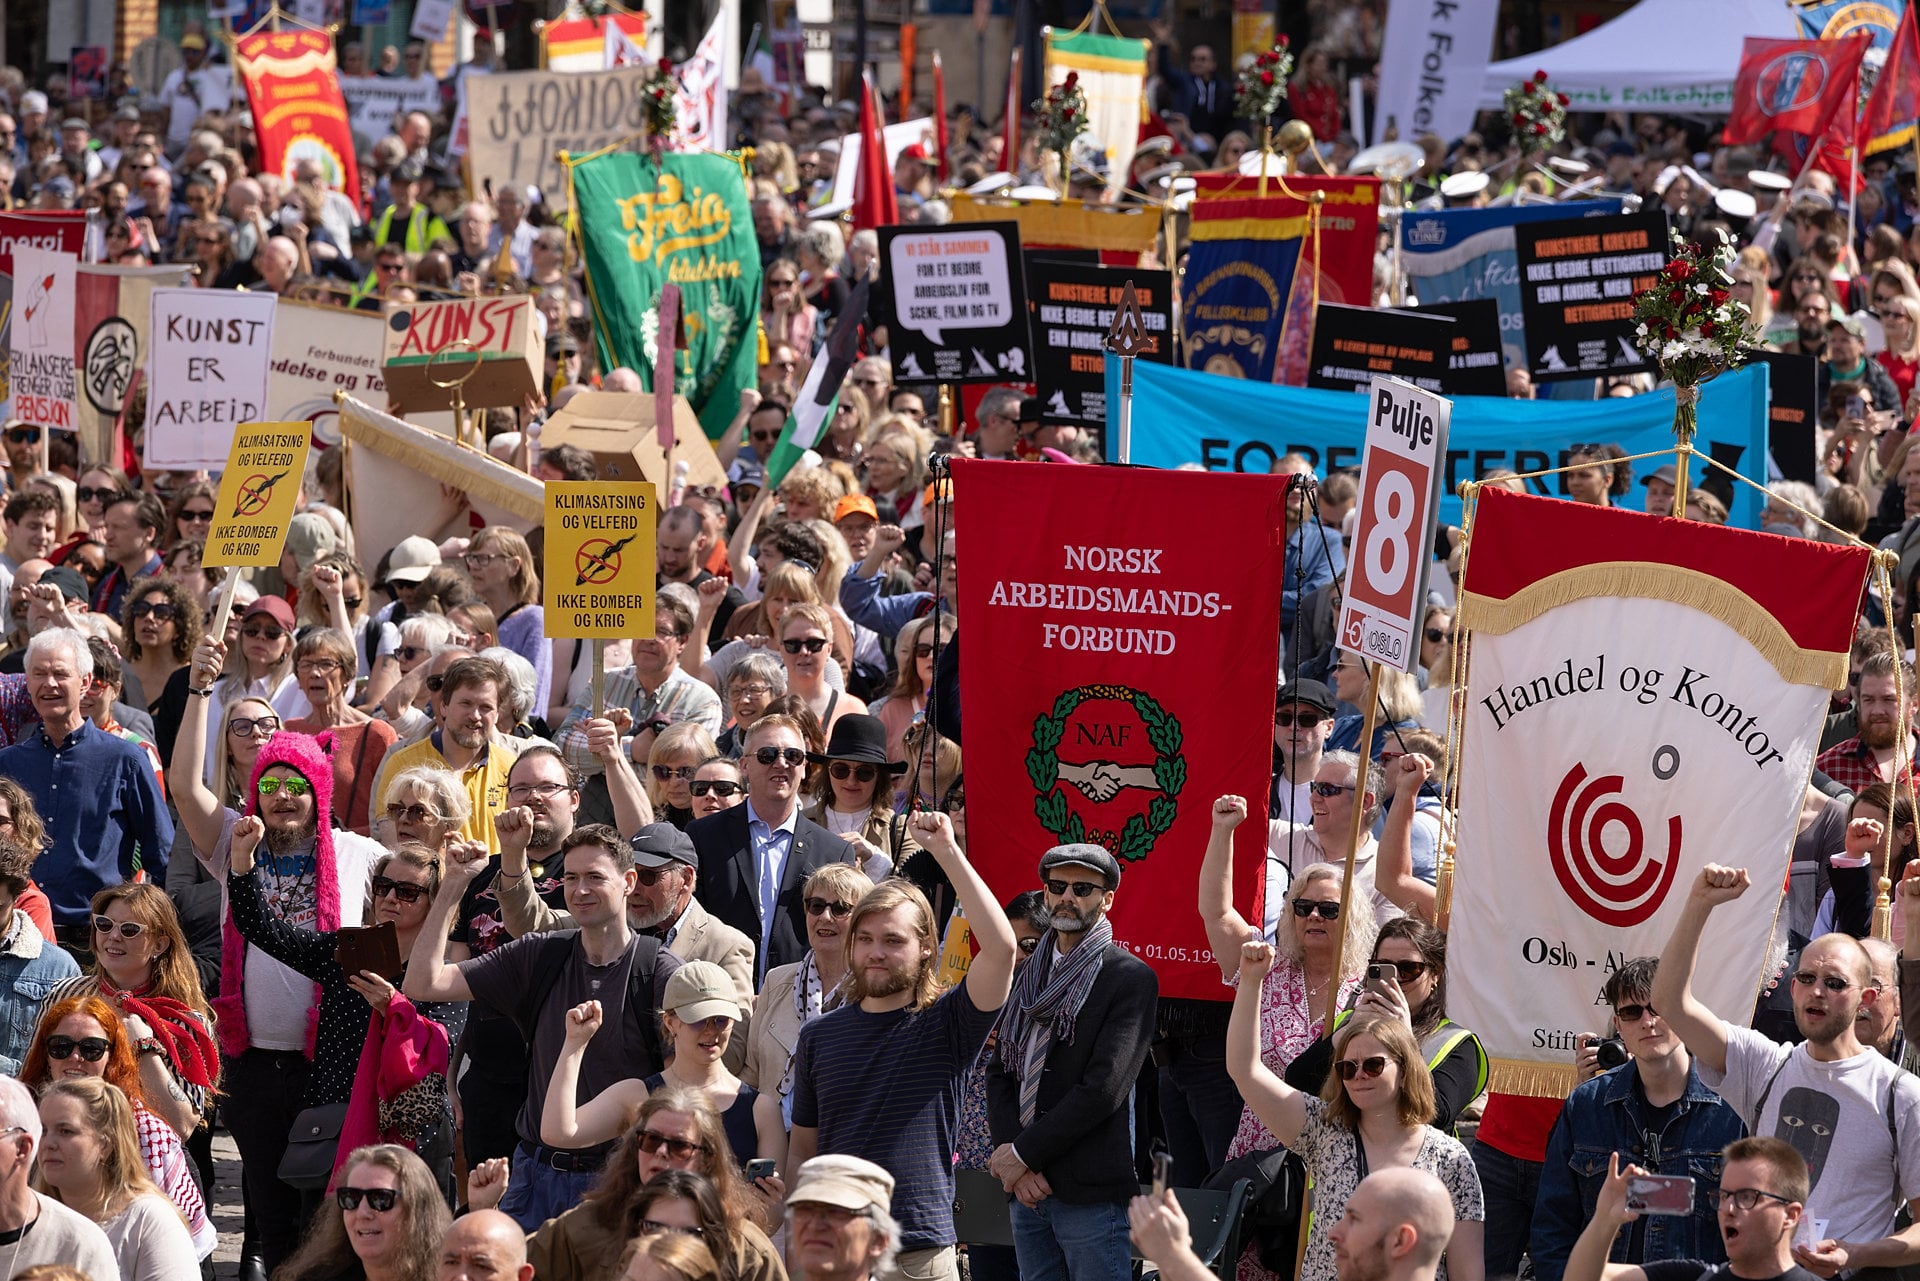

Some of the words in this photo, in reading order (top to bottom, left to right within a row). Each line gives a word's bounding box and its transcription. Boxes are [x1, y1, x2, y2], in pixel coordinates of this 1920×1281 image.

[616, 174, 731, 269] Freia
[0, 228, 64, 254] nergi
[944, 240, 990, 255] SAMMEN
[1535, 235, 1600, 258] KUNSTNERE
[1602, 230, 1648, 251] KREVER
[668, 254, 742, 282] klubben
[917, 263, 934, 277] FOR
[937, 262, 948, 277] ET
[951, 261, 982, 276] BEDRE
[1527, 263, 1553, 281] IKKE
[1554, 259, 1590, 279] BEDRE
[1591, 252, 1664, 276] RETTIGHETER
[914, 284, 967, 299] ARBEIDSLIV
[971, 282, 990, 296] FOR
[1049, 282, 1107, 304] KUNSTNERE
[1536, 285, 1561, 303] ENN
[1562, 281, 1603, 302] ANDRE,
[1603, 278, 1632, 297] MEN
[909, 305, 942, 321] SCENE,
[944, 304, 967, 318] FILM
[971, 304, 984, 317] OG
[988, 303, 999, 317] TV
[1040, 305, 1065, 323] IKKE
[1065, 307, 1096, 326] BEDRE
[166, 314, 265, 346] KUNST
[398, 300, 529, 356] KUNST
[1048, 329, 1069, 347] ENN
[11, 351, 75, 380] FRILANSERE
[307, 346, 375, 369] Forbundet
[1399, 347, 1434, 362] APPLAUS
[188, 357, 225, 382] ER
[11, 375, 51, 397] TRENGER
[334, 372, 358, 391] og
[1375, 388, 1434, 451] Pulje
[238, 434, 303, 448] KLIMASATSING
[238, 454, 249, 466] OG
[252, 453, 294, 466] VELFERD
[555, 495, 645, 509] KLIMASATSING
[215, 525, 237, 539] IKKE
[237, 526, 278, 539] BOMBER
[562, 515, 579, 529] OG
[583, 515, 637, 529] VELFERD
[1365, 470, 1415, 595] 8
[222, 543, 234, 556] OG
[236, 543, 260, 556] KRIG
[1063, 545, 1162, 574] NORSK
[557, 594, 586, 609] IKKE
[590, 594, 642, 609] BOMBER
[988, 581, 1232, 619] ARBEIDSMANDS-
[574, 613, 591, 628] OG
[595, 613, 625, 628] KRIG
[1043, 623, 1176, 655] FORBUND
[1369, 630, 1402, 660] OSLO
[1480, 654, 1605, 731] Handel
[1619, 666, 1664, 705] og
[1669, 666, 1784, 770] Kontor
[1076, 723, 1132, 747] NAF
[1522, 937, 1578, 970] Oslo
